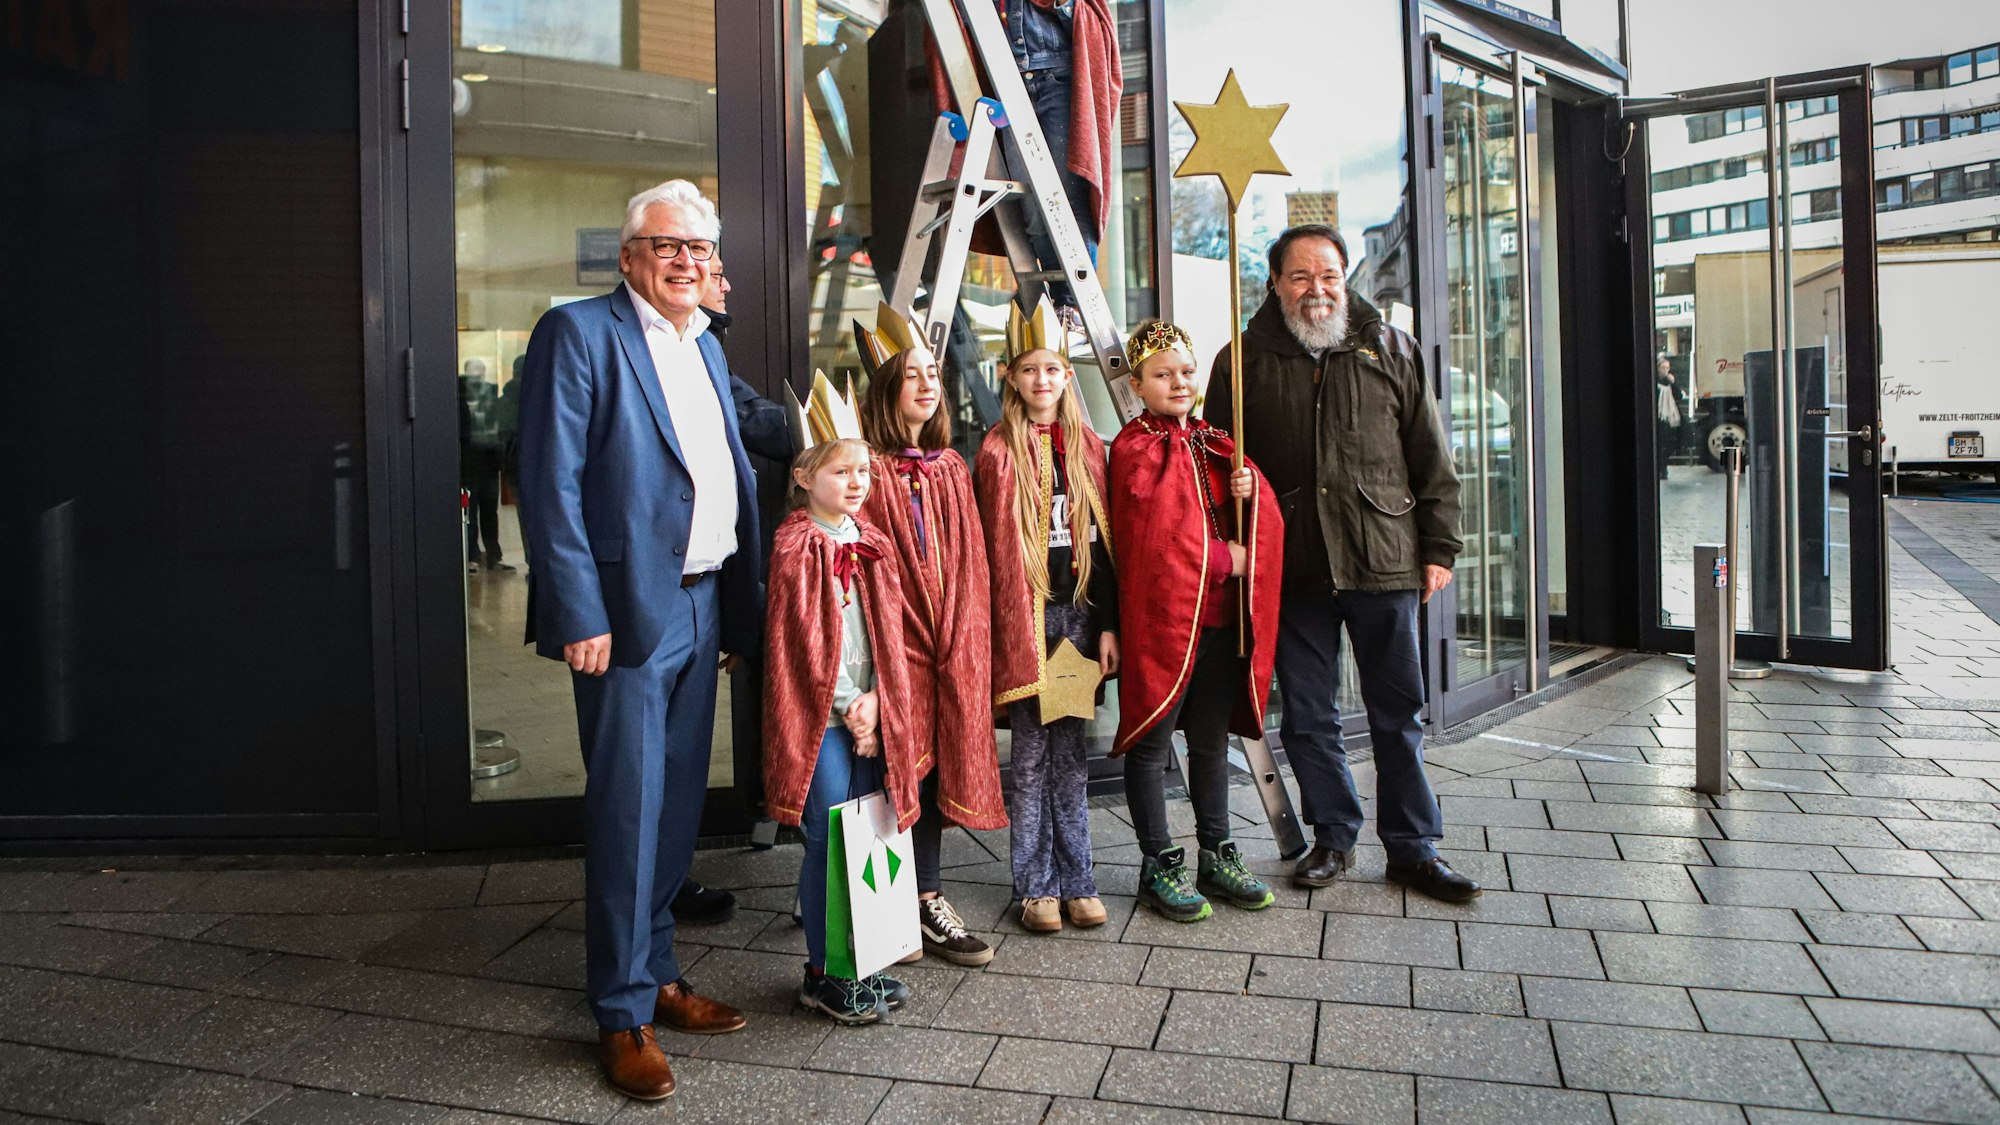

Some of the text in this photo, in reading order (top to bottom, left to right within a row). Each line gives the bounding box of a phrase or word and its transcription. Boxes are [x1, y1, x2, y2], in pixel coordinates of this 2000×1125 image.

[930, 321, 947, 361] 9
[1954, 446, 1978, 454] ZF 78
